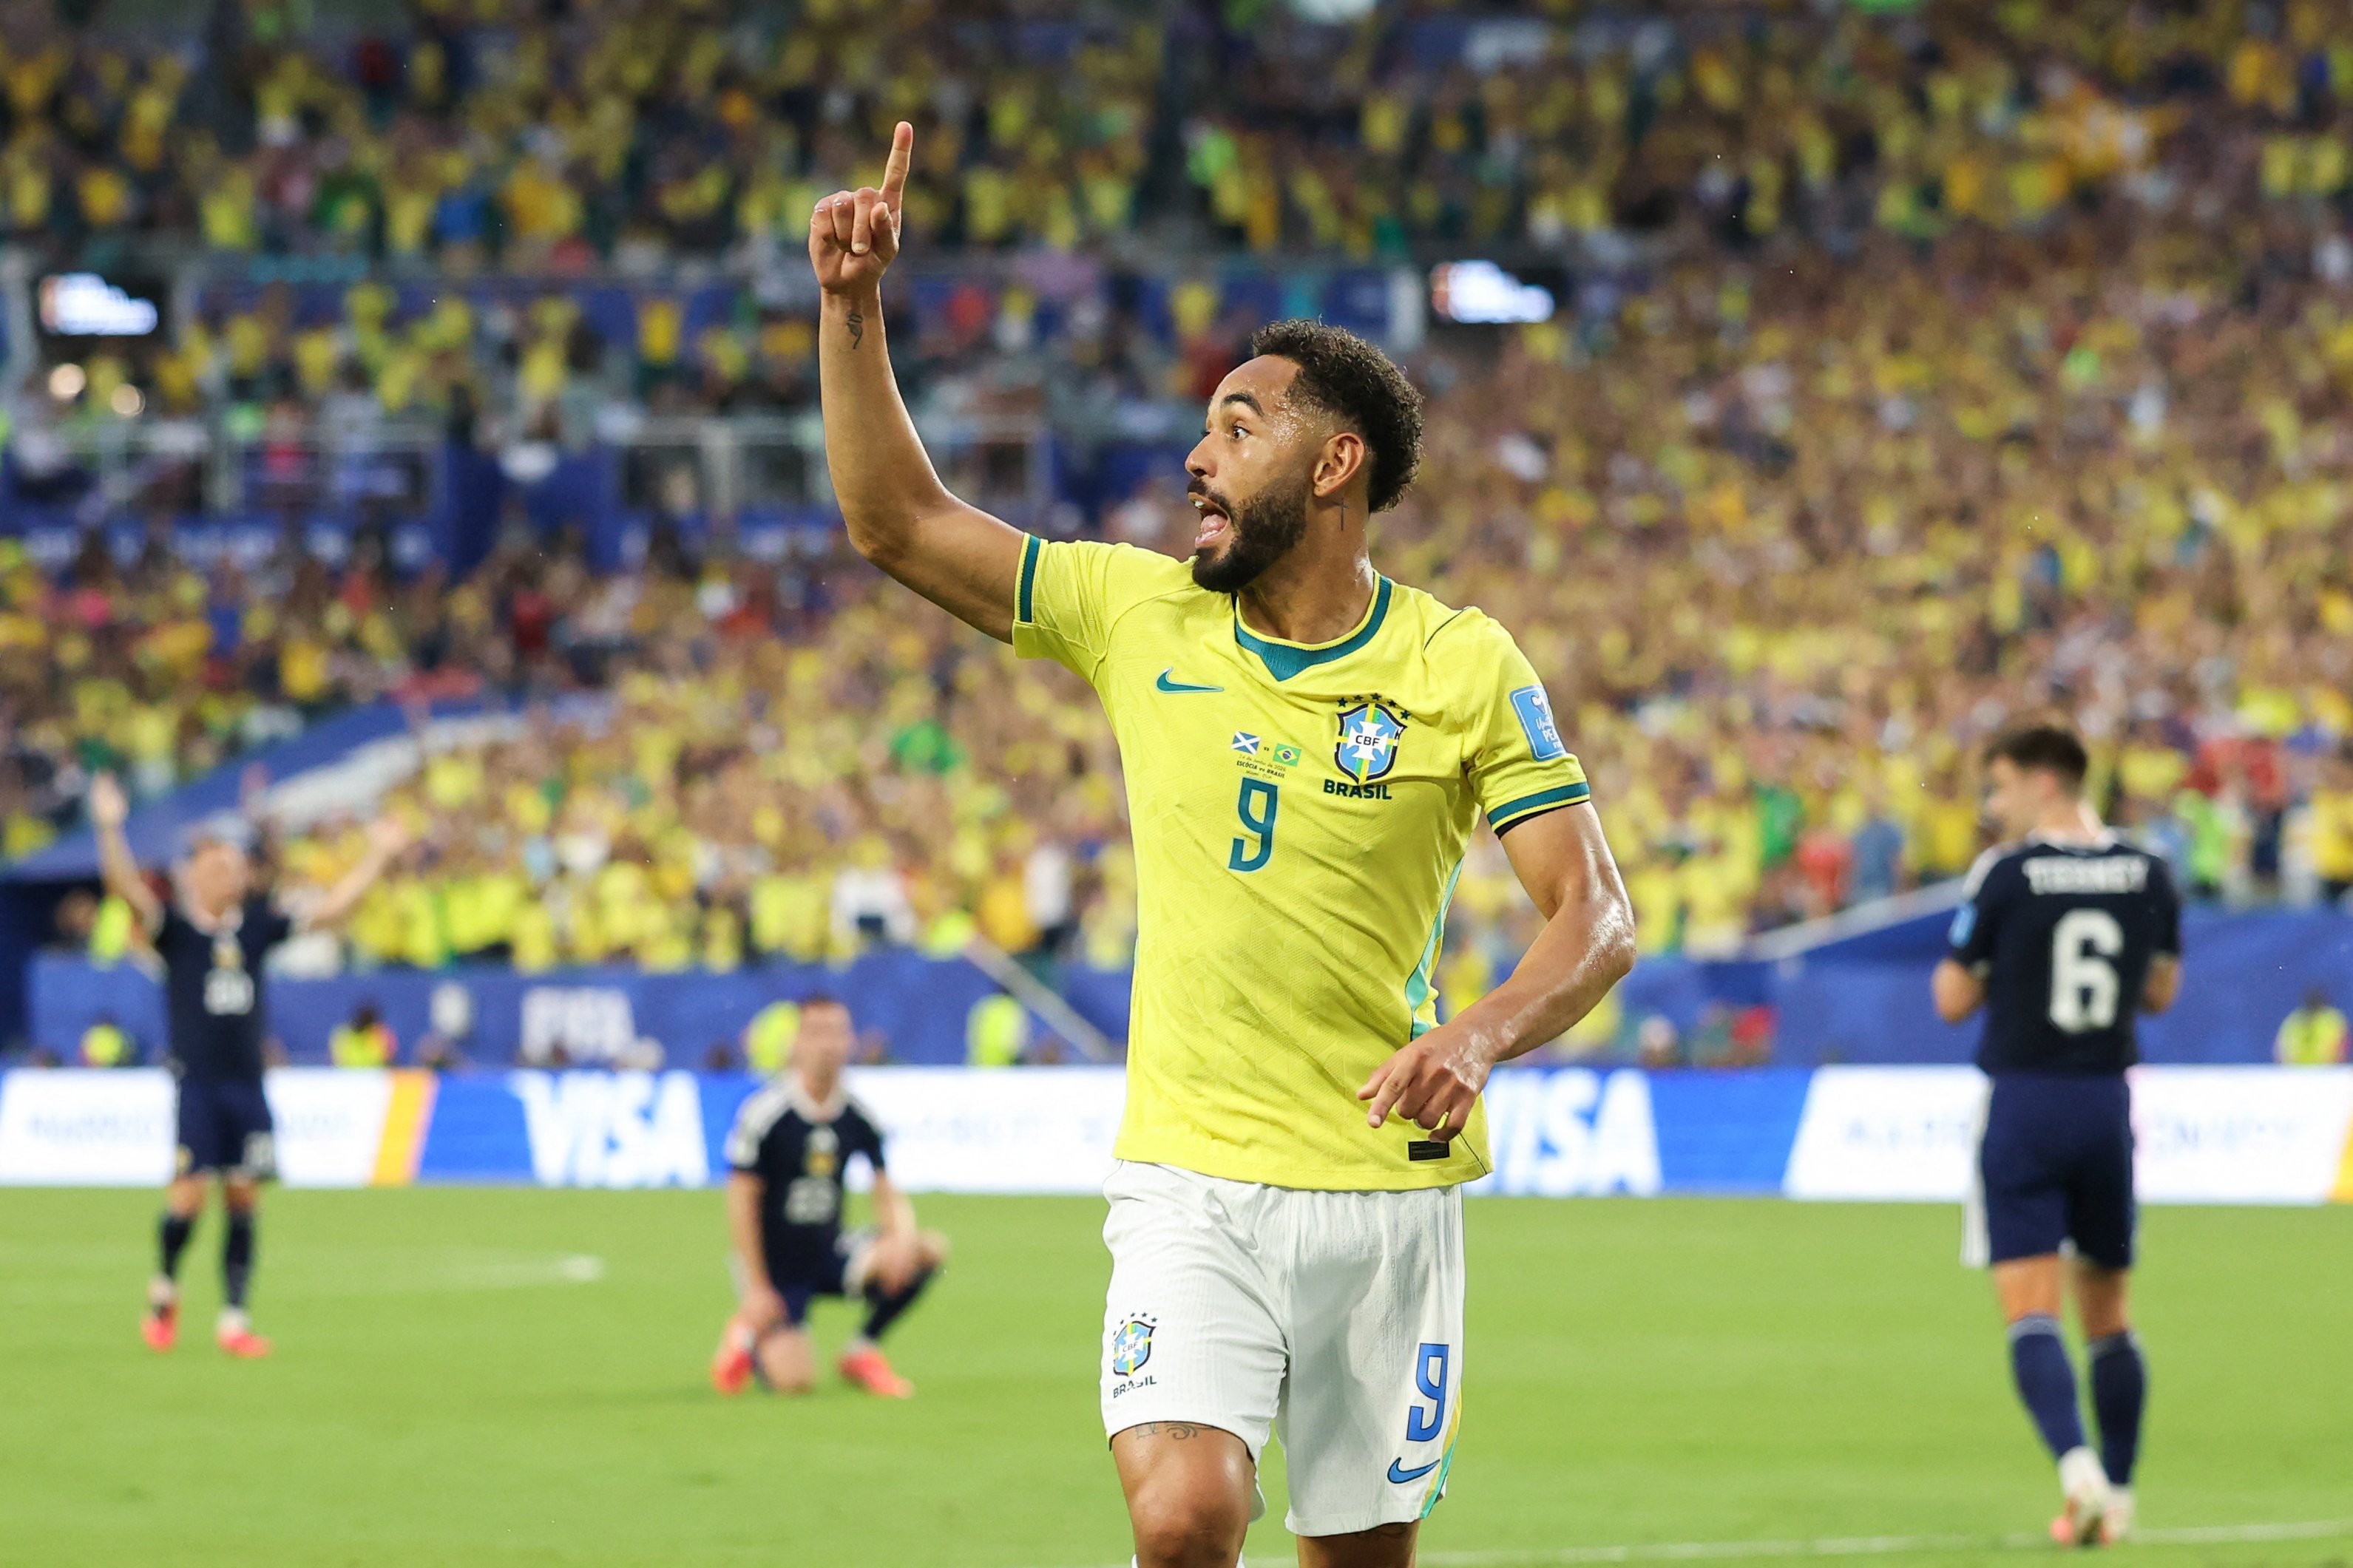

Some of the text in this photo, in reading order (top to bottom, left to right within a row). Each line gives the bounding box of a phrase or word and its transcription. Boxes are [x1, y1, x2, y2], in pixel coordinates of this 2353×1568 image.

[1355, 735, 1381, 747] CBF
[1267, 769, 1285, 778] BRASIL
[1323, 778, 1392, 800] BRASIL
[1228, 776, 1279, 872] 9
[2048, 908, 2124, 1034] 6
[506, 1068, 709, 1192] VISA
[1123, 1342, 1138, 1352] CBF
[1113, 1375, 1157, 1399] BRASIL
[1406, 1343, 1449, 1442] 9
